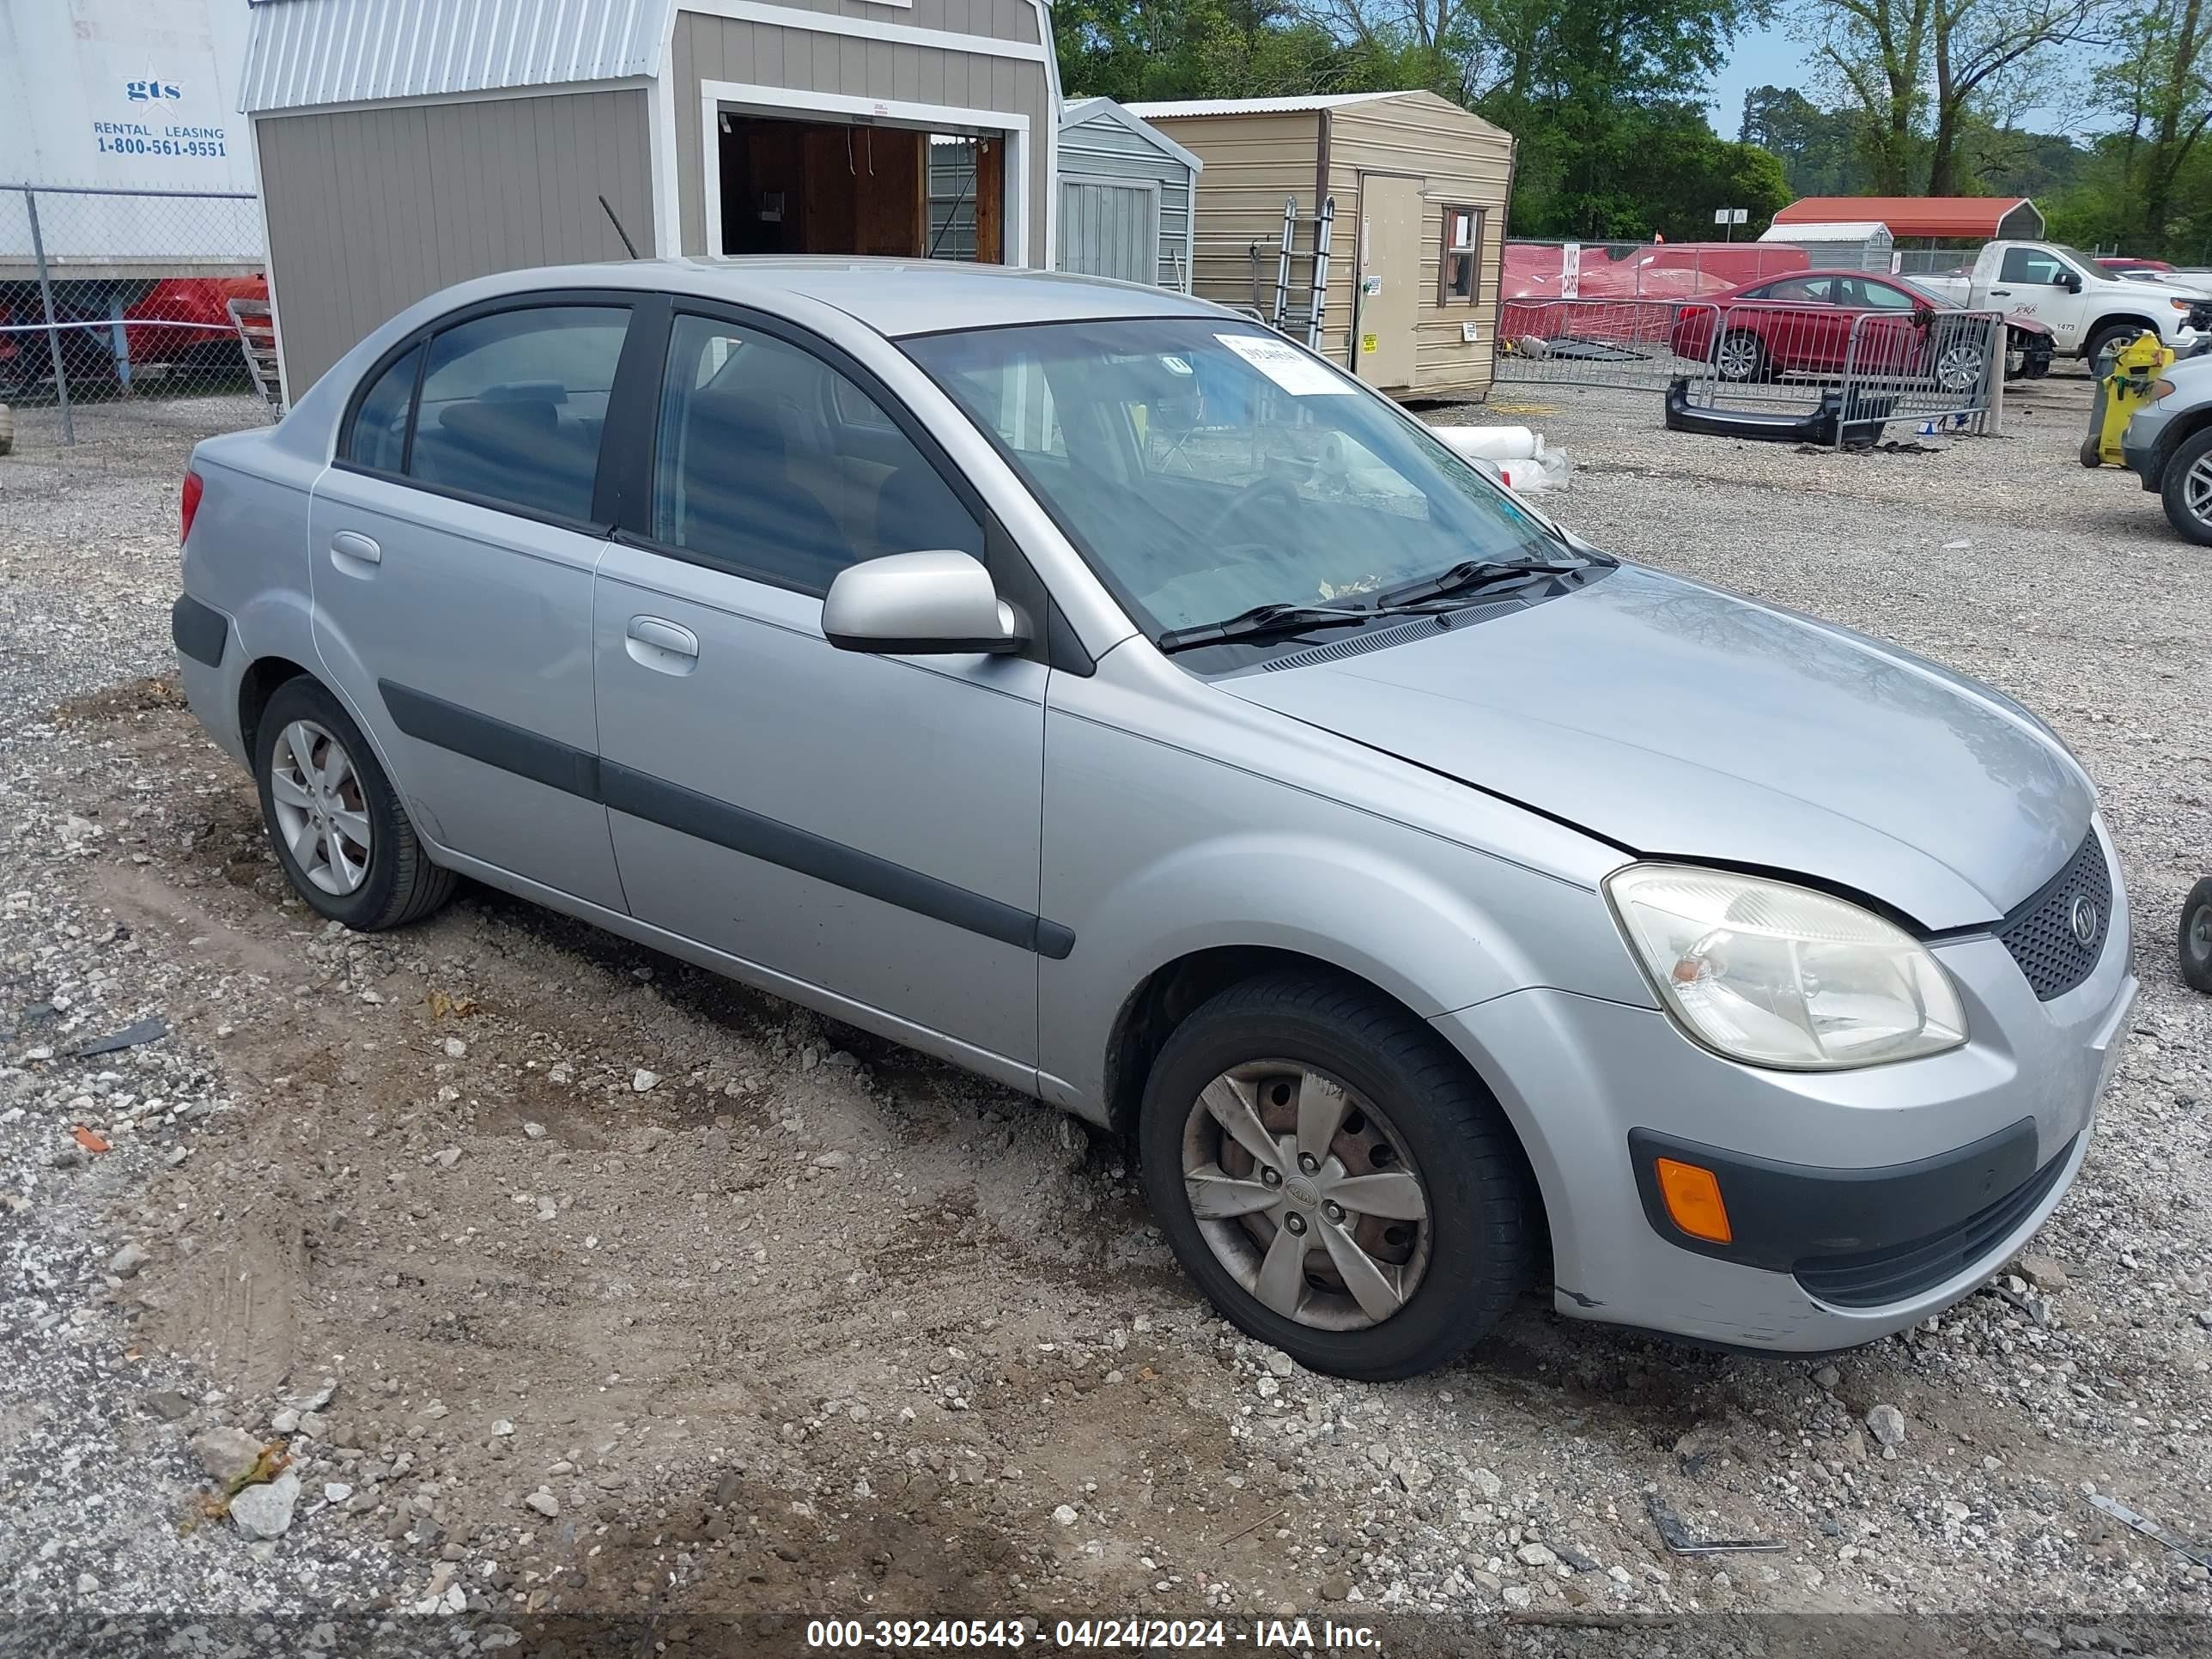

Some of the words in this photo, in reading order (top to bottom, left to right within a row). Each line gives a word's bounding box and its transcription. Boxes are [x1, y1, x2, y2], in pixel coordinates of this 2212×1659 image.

[127, 81, 181, 102] gts
[94, 122, 152, 136] RENTAL
[165, 126, 224, 139] LEASING
[98, 137, 226, 156] 1-800-561-9551
[1735, 210, 1745, 222] A
[1568, 250, 1577, 269] VIC
[1564, 274, 1577, 294] CARS
[1291, 1187, 1316, 1204] KIA
